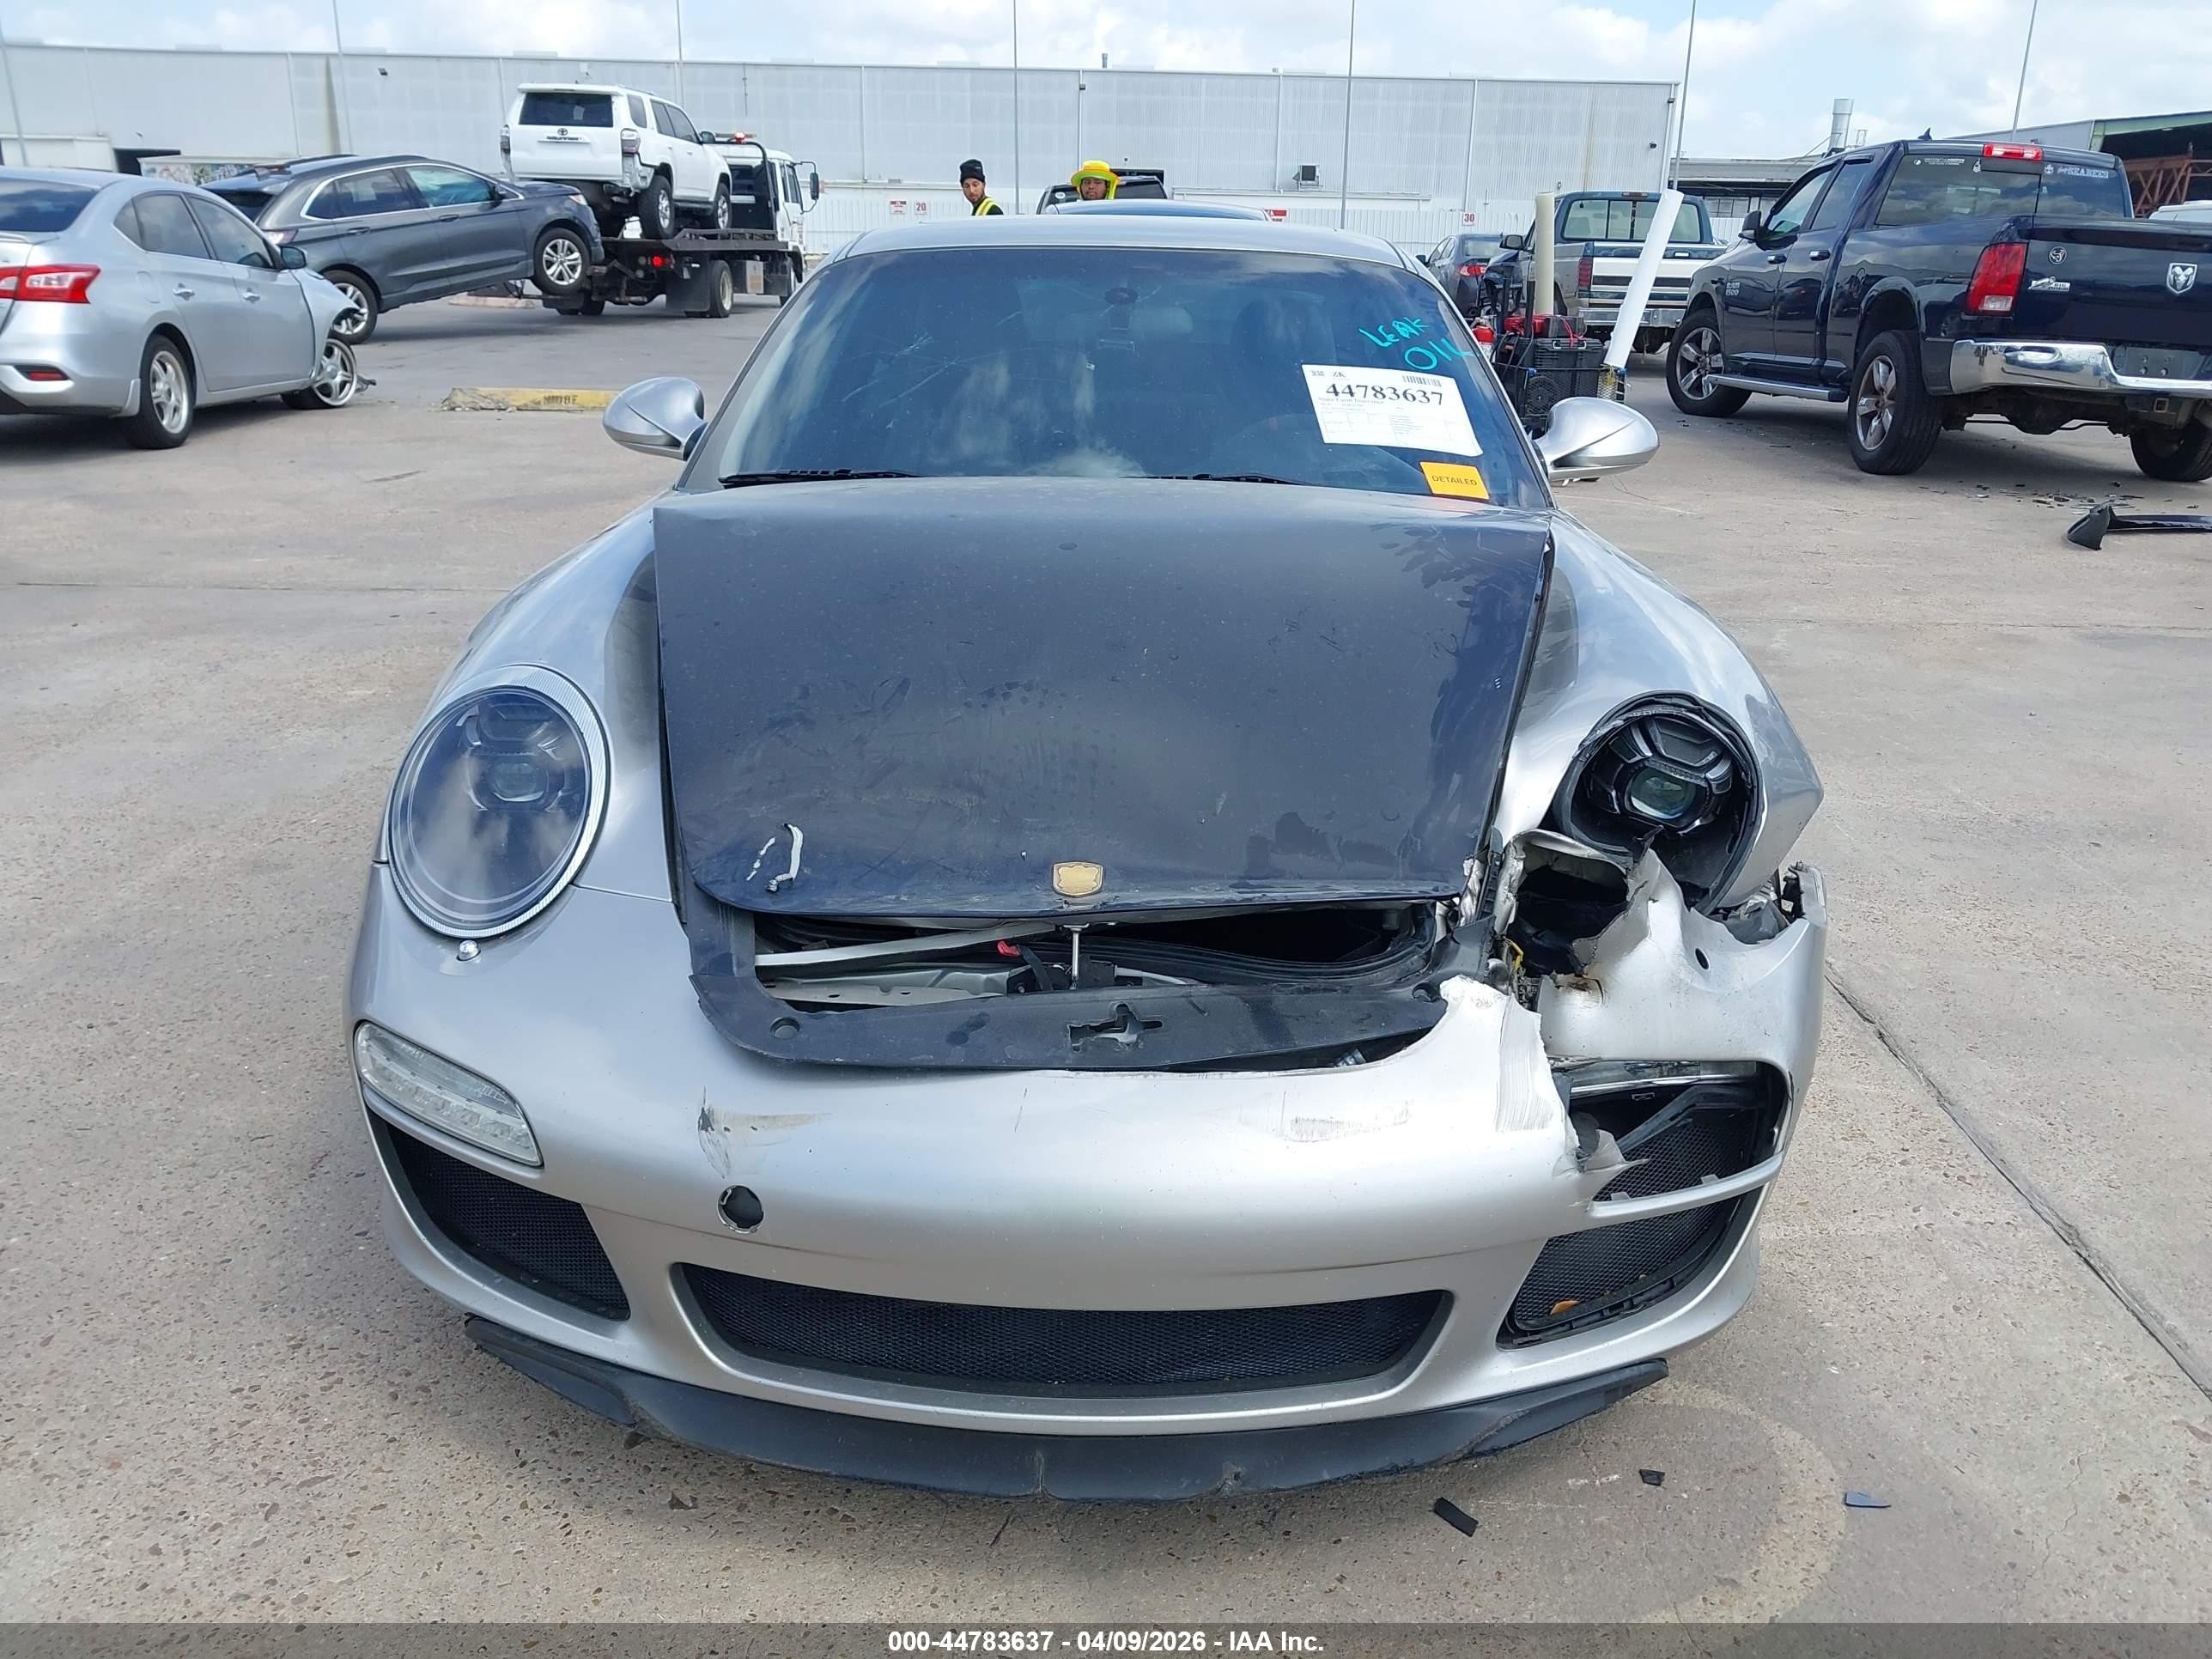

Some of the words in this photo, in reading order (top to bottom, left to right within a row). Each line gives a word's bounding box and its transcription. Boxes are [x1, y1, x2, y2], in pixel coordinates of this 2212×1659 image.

[915, 202, 927, 211] 20
[1464, 213, 1475, 222] 30
[1404, 337, 1480, 370] OIL
[1325, 383, 1443, 406] 44783637
[1431, 475, 1478, 486] DETAILED
